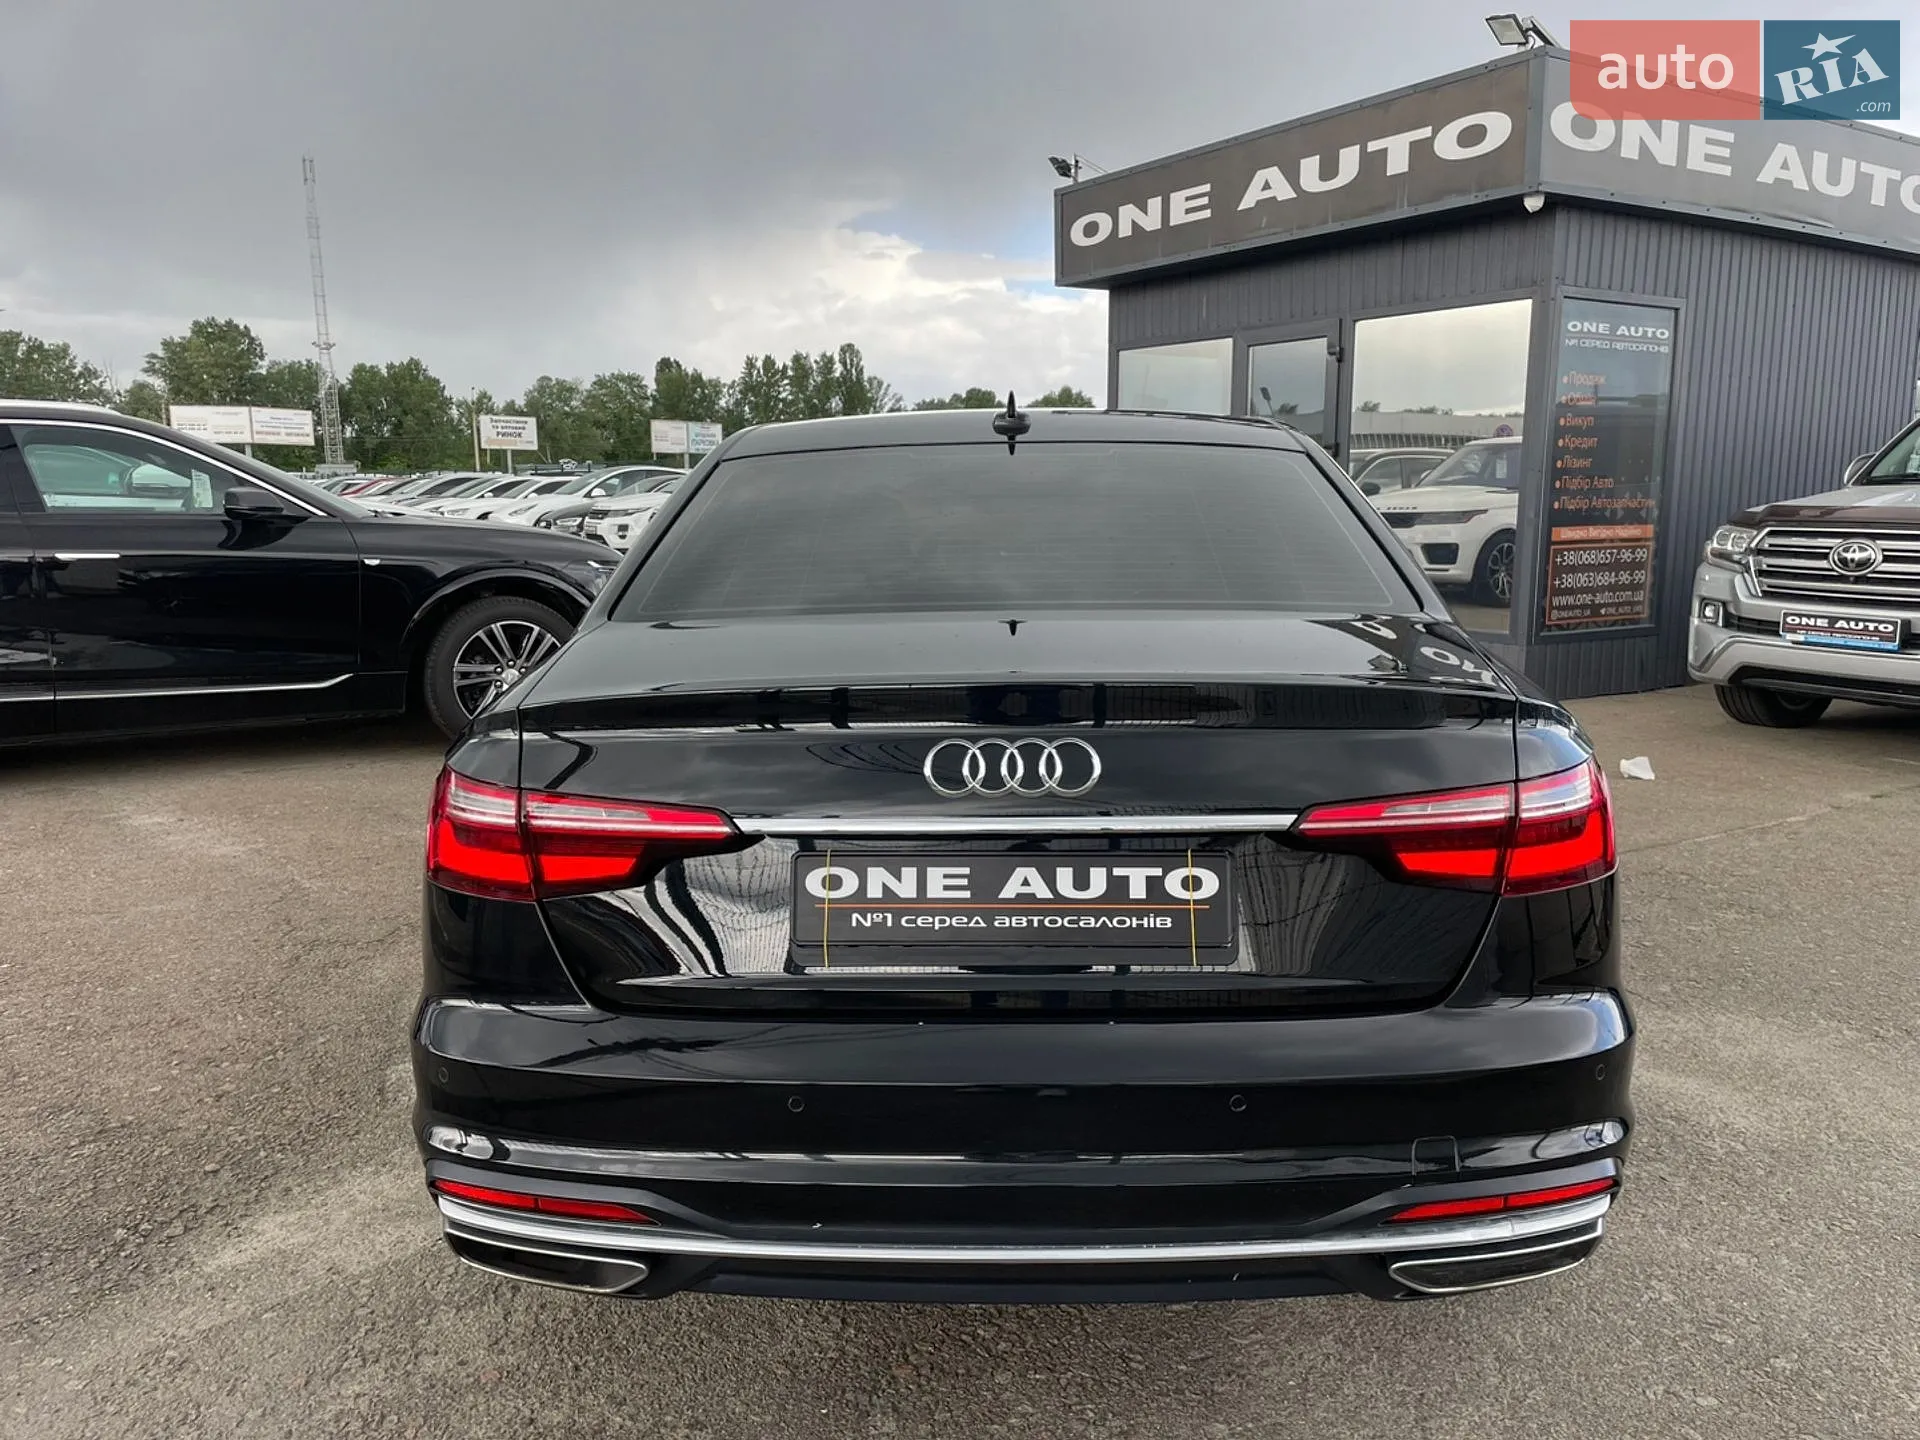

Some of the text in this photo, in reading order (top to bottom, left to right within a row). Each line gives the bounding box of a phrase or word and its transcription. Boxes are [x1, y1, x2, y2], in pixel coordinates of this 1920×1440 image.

[1550, 101, 1735, 177] ONE
[1070, 111, 1512, 247] ONE AUTO
[1567, 321, 1670, 339] ONE AUTO
[1568, 371, 1607, 387] Продаж
[1566, 413, 1595, 430] Викуп
[496, 431, 523, 439] РИНОК
[1564, 434, 1598, 450] Кредит
[1562, 454, 1593, 469] Лізинг
[1561, 475, 1615, 491] Підбір Авто
[1560, 495, 1590, 511] Підбір
[1555, 548, 1648, 566] +38(068)657-96-99
[1553, 570, 1646, 588] +38(063)684-96-99
[1552, 590, 1644, 607] www.one-auto.com.ua
[1786, 615, 1894, 632] ONE AUTO
[805, 866, 1220, 901] ONE AUTO
[901, 914, 987, 931] серед
[994, 912, 1172, 929] автосалонів
